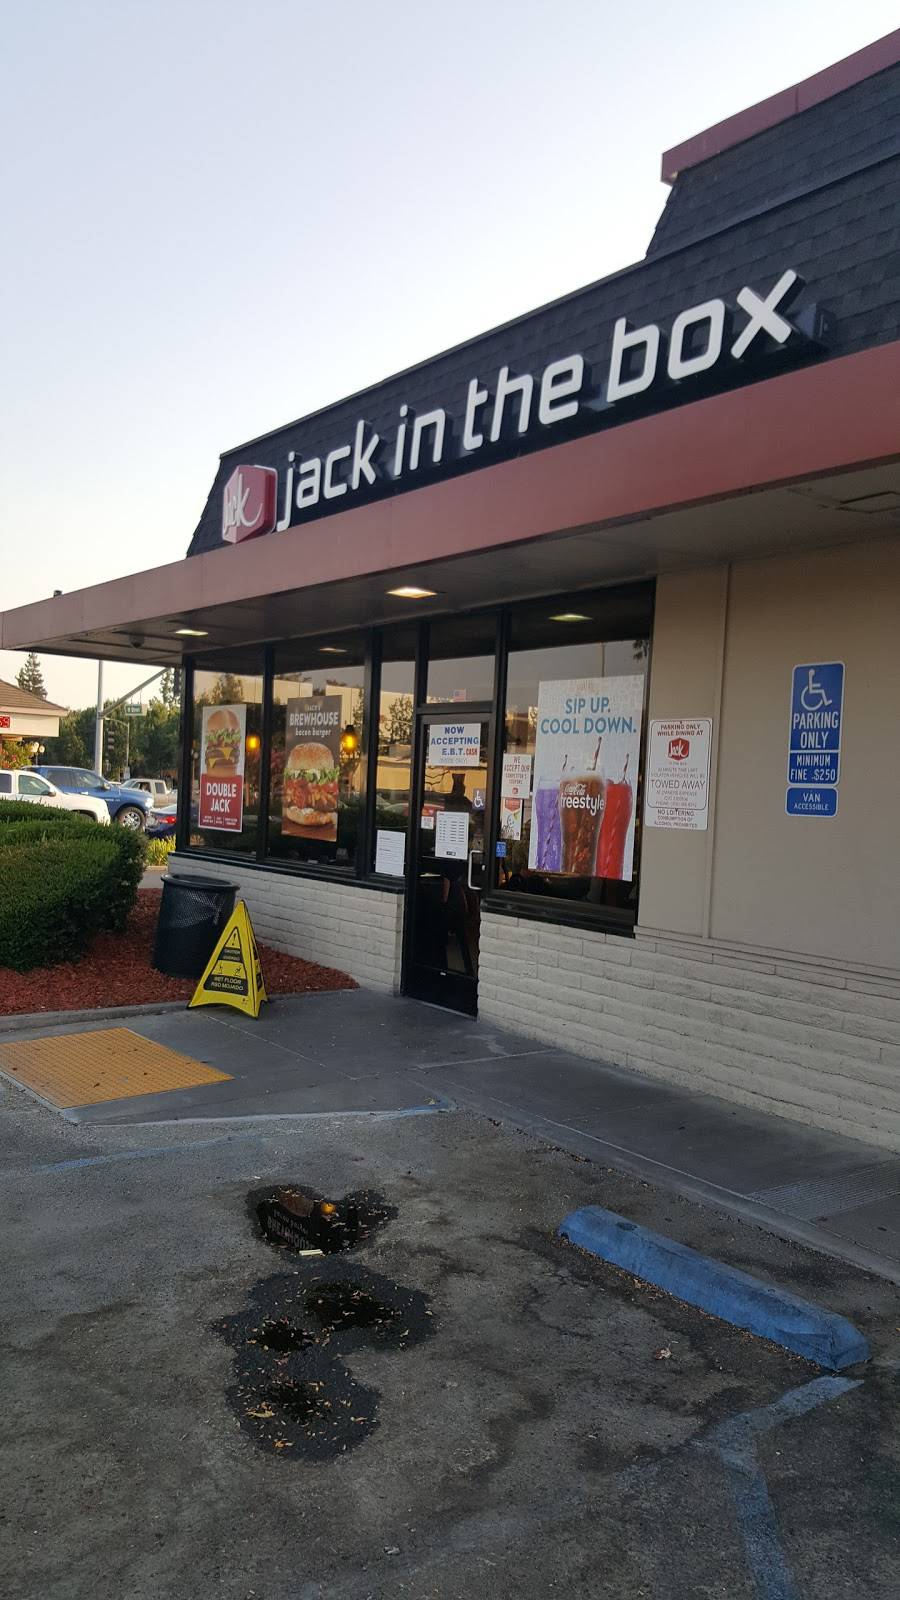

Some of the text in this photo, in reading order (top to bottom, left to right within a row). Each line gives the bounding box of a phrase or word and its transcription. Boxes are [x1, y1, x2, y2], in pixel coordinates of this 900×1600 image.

[277, 269, 798, 532] jack in the box
[566, 696, 611, 714] SIP UP.
[289, 711, 339, 727] BREWHOUSE
[540, 716, 637, 734] COOL DOWN.
[793, 711, 839, 730] PARKING
[444, 726, 465, 735] NOW
[430, 737, 479, 745] ACCEPTING
[800, 731, 828, 749] ONLY
[441, 747, 478, 756] E.B.T. CASH
[796, 754, 831, 766] MINIMUM
[790, 768, 836, 781] FINE $250
[206, 782, 237, 798] DOUBLE
[650, 779, 706, 790] TOWED AWAY
[560, 793, 605, 816] freestyle
[802, 793, 821, 802] VAN
[210, 798, 231, 813] JACK
[793, 803, 829, 811] ACCESSIBLE
[666, 809, 694, 817] LOTERING
